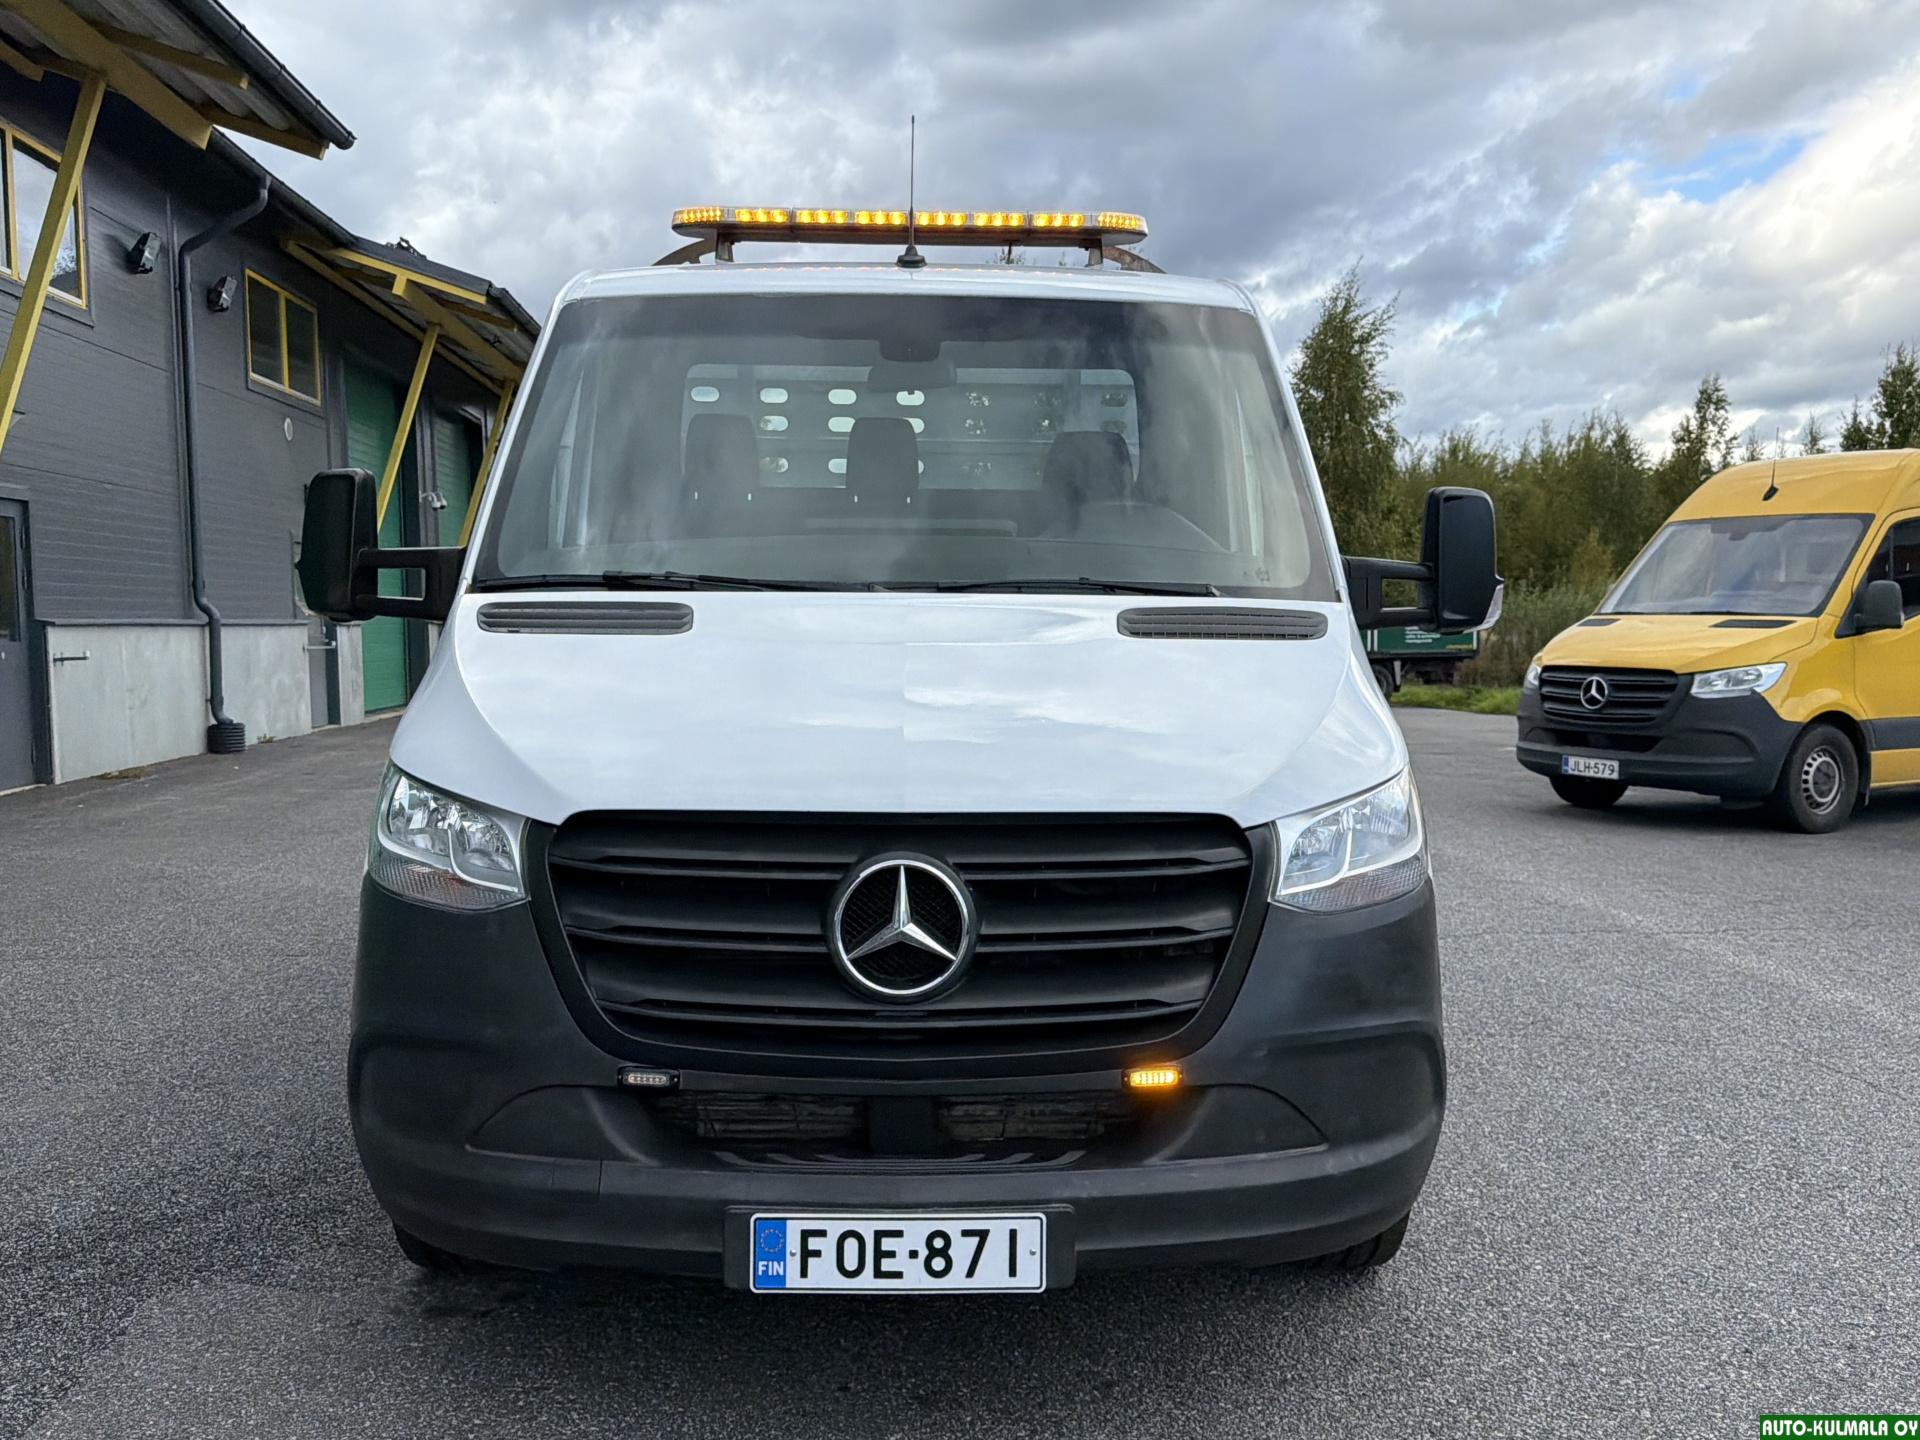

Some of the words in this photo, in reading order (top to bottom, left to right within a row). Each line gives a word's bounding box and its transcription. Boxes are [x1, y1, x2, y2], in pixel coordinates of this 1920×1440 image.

[1570, 760, 1615, 776] JLH-579
[800, 1228, 1018, 1279] FOE-871
[758, 1261, 784, 1276] FIN
